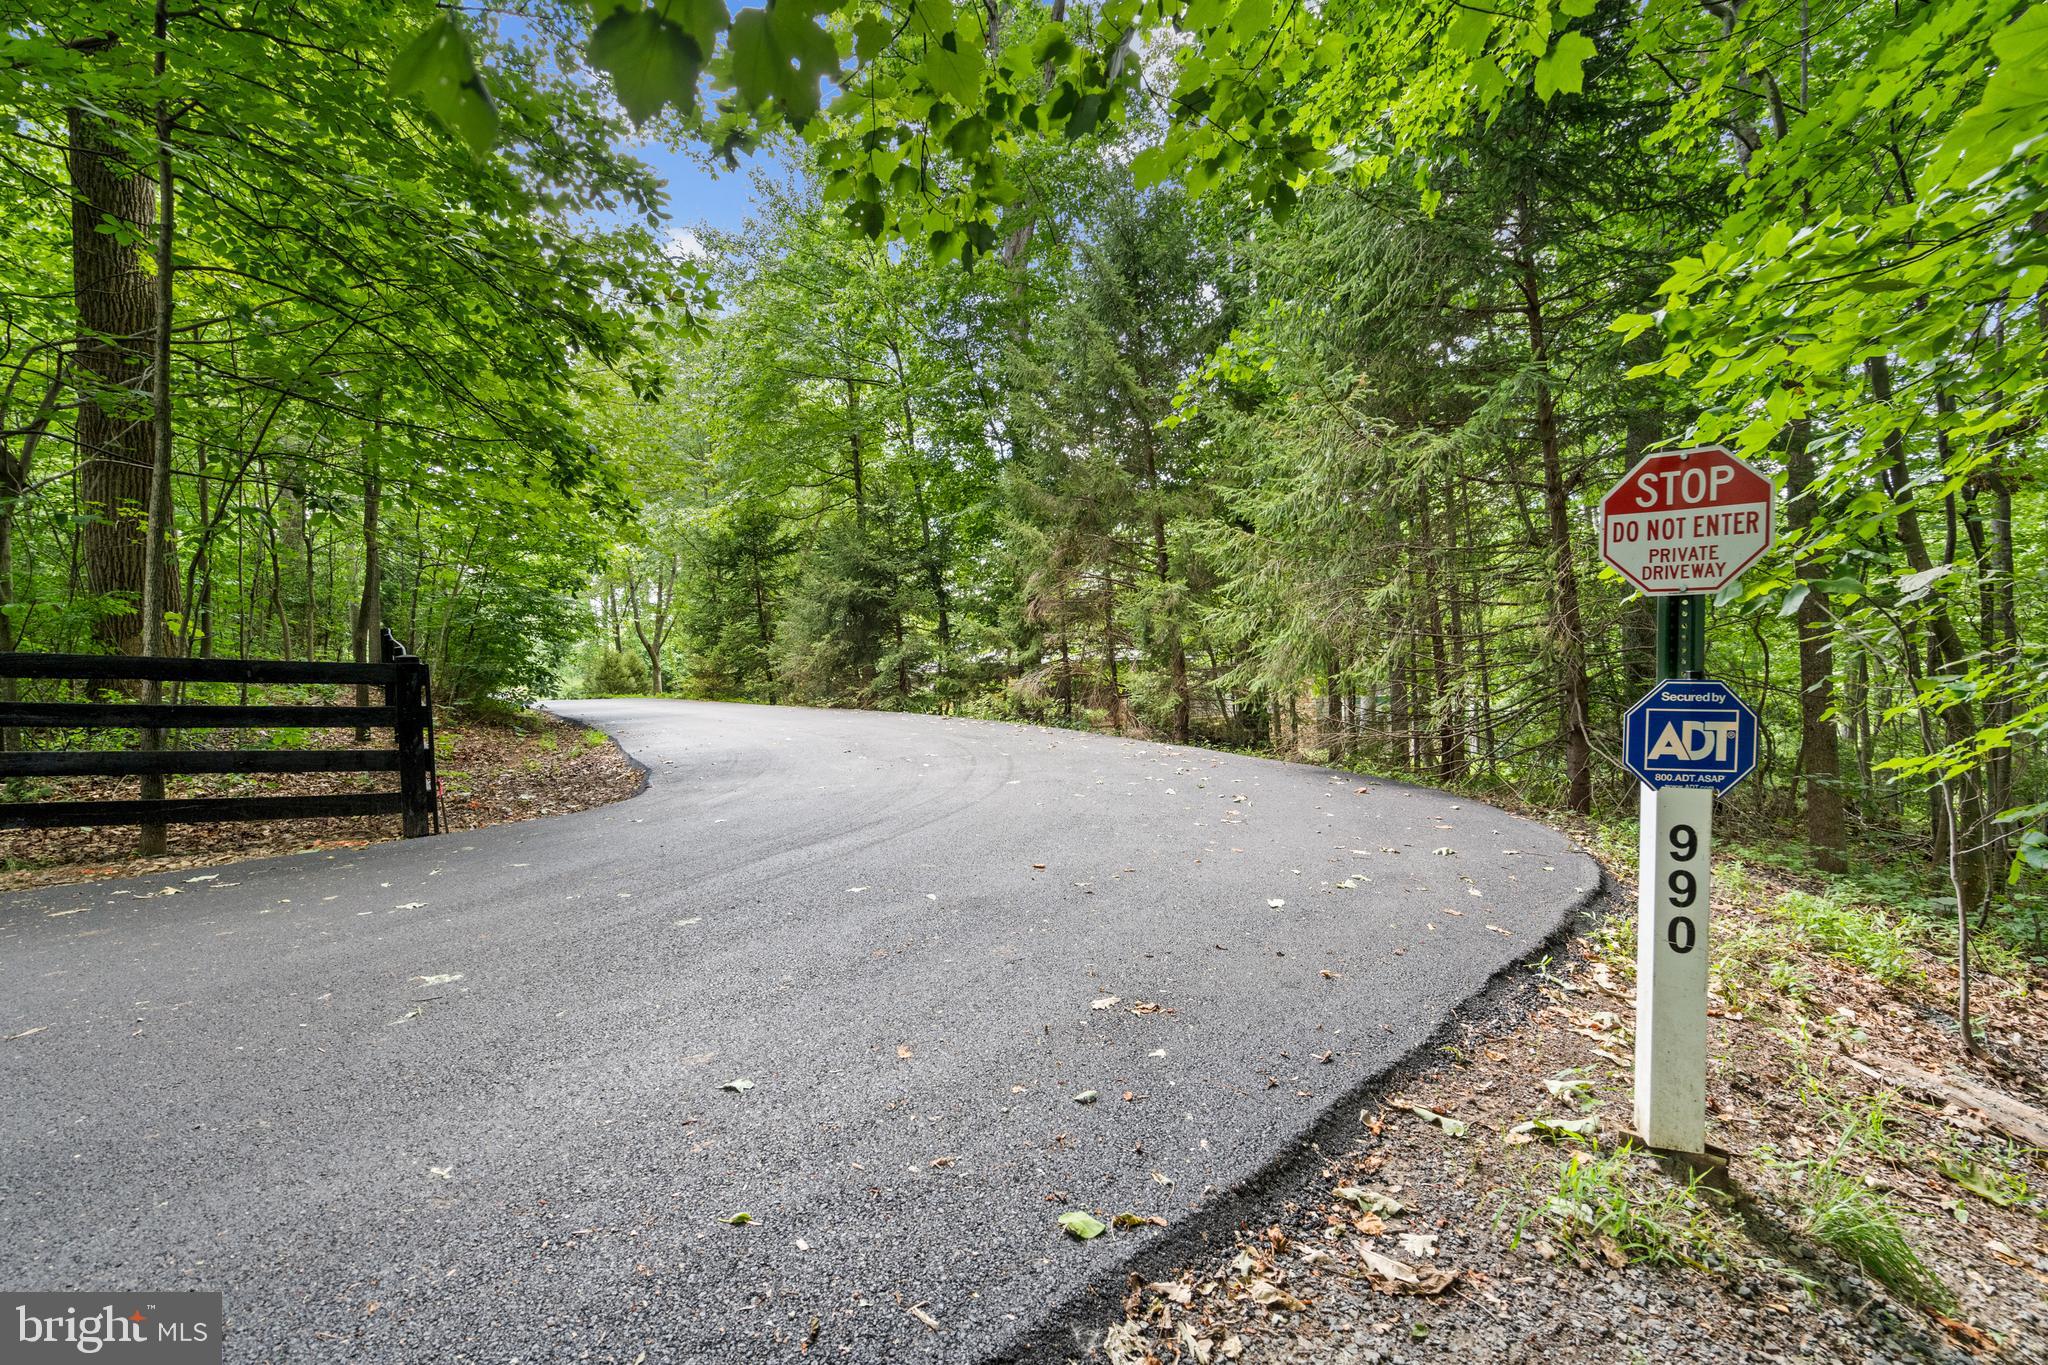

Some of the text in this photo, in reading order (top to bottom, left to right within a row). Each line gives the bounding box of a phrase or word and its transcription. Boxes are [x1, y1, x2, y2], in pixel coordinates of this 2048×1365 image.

[1635, 465, 1735, 508] STOP
[1613, 511, 1760, 543] DO NOT ENTER
[1649, 545, 1719, 564] PRIVATE
[1642, 562, 1726, 580] DRIVEWAY
[1661, 691, 1726, 704] Secured by
[1647, 720, 1737, 762] ADT
[1667, 824, 1698, 954] 990
